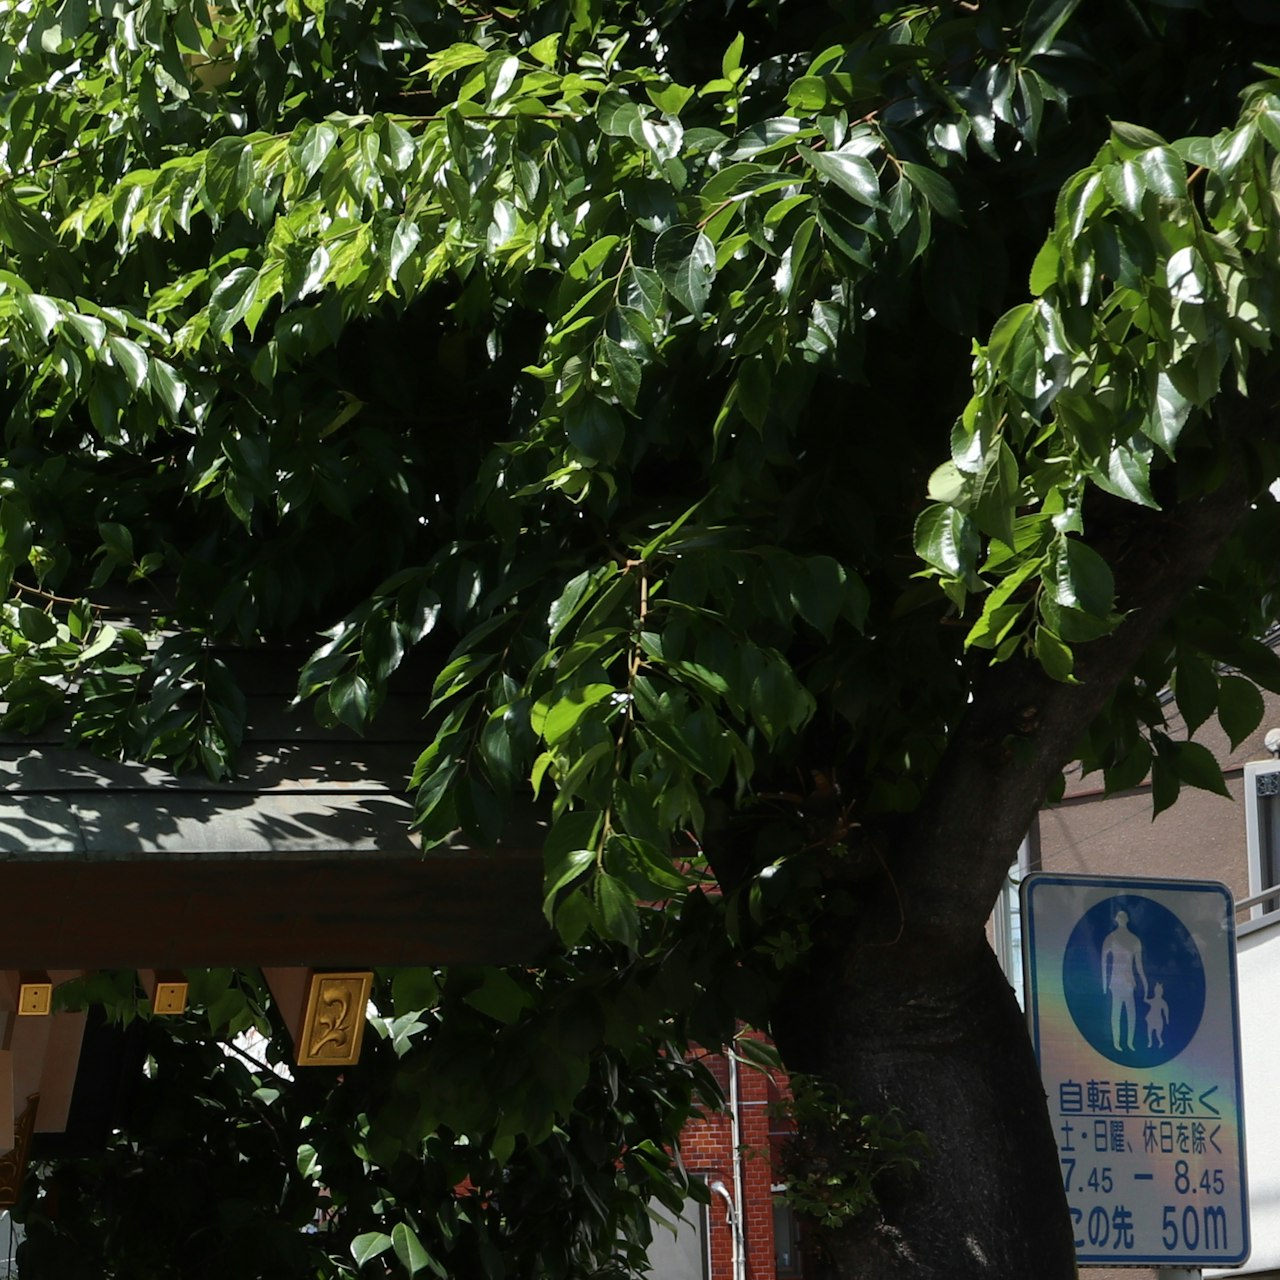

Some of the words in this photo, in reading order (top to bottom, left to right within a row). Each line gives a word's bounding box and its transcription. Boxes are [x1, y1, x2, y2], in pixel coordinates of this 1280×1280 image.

[1059, 1079, 1220, 1115] 自転車を除く
[1060, 1119, 1222, 1154] 土・日曜、休日を除く
[1061, 1158, 1113, 1193] 7.45
[1174, 1160, 1225, 1195] 8.45
[1163, 1206, 1227, 1250] 50m
